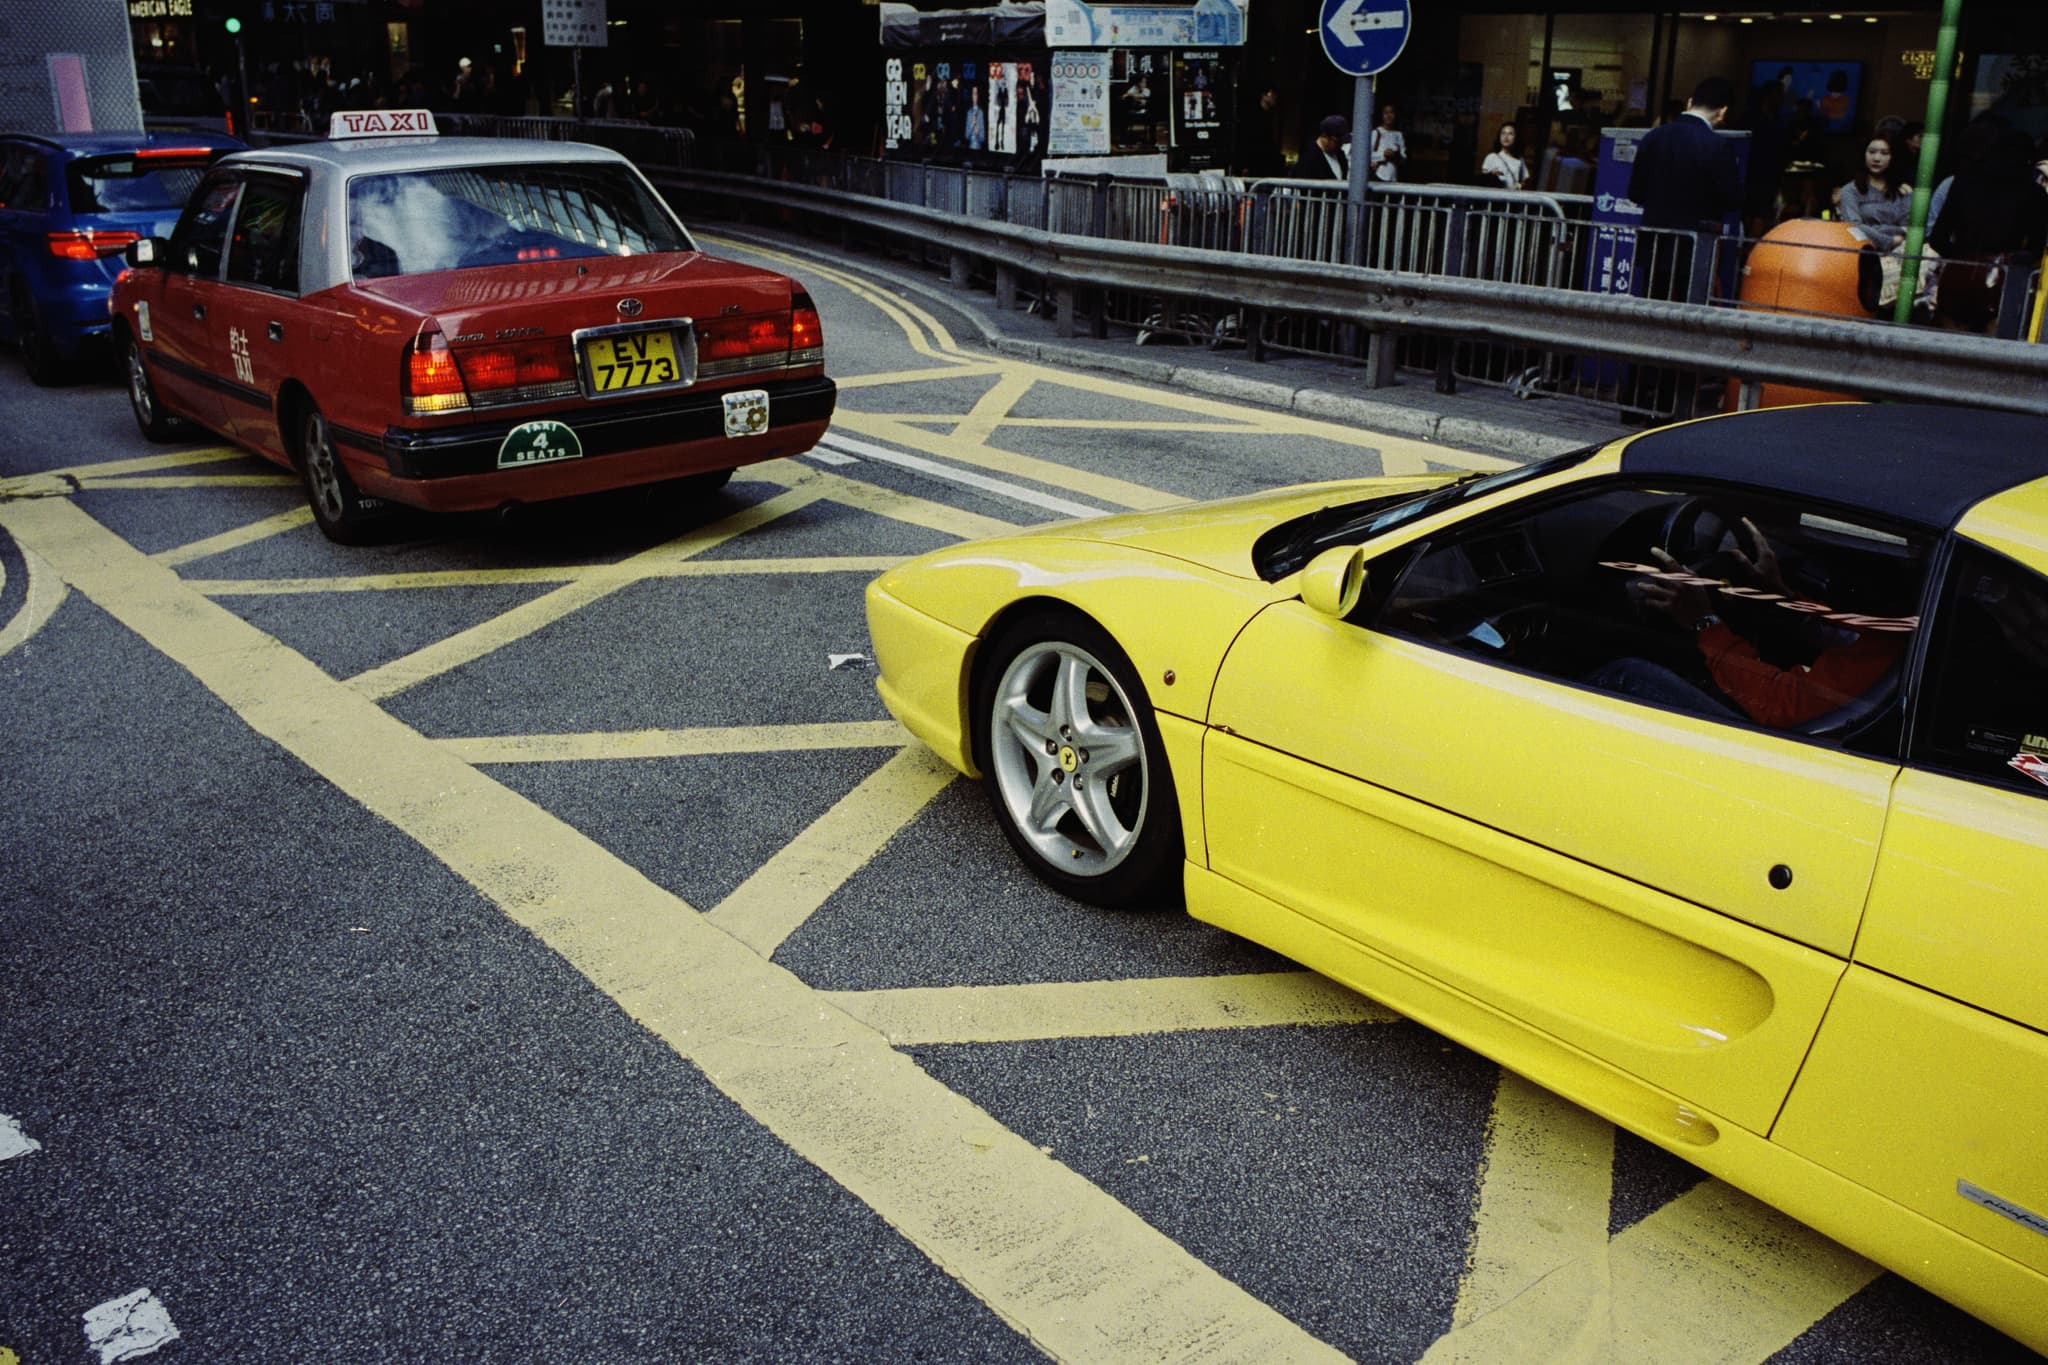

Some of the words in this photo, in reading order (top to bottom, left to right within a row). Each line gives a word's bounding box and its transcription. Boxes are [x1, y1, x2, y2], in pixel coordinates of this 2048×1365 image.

[169, 0, 192, 16] EAGLE
[886, 81, 907, 105] MEN
[343, 113, 428, 132] TAXI
[886, 115, 912, 140] YEAR
[1615, 259, 1631, 296] 小心
[230, 327, 249, 356] 的士
[612, 334, 648, 362] EV
[232, 353, 255, 385] TAXI
[597, 357, 674, 389] 7773
[523, 423, 557, 433] TAXI
[533, 432, 549, 449] 4
[516, 448, 566, 461] SEATS
